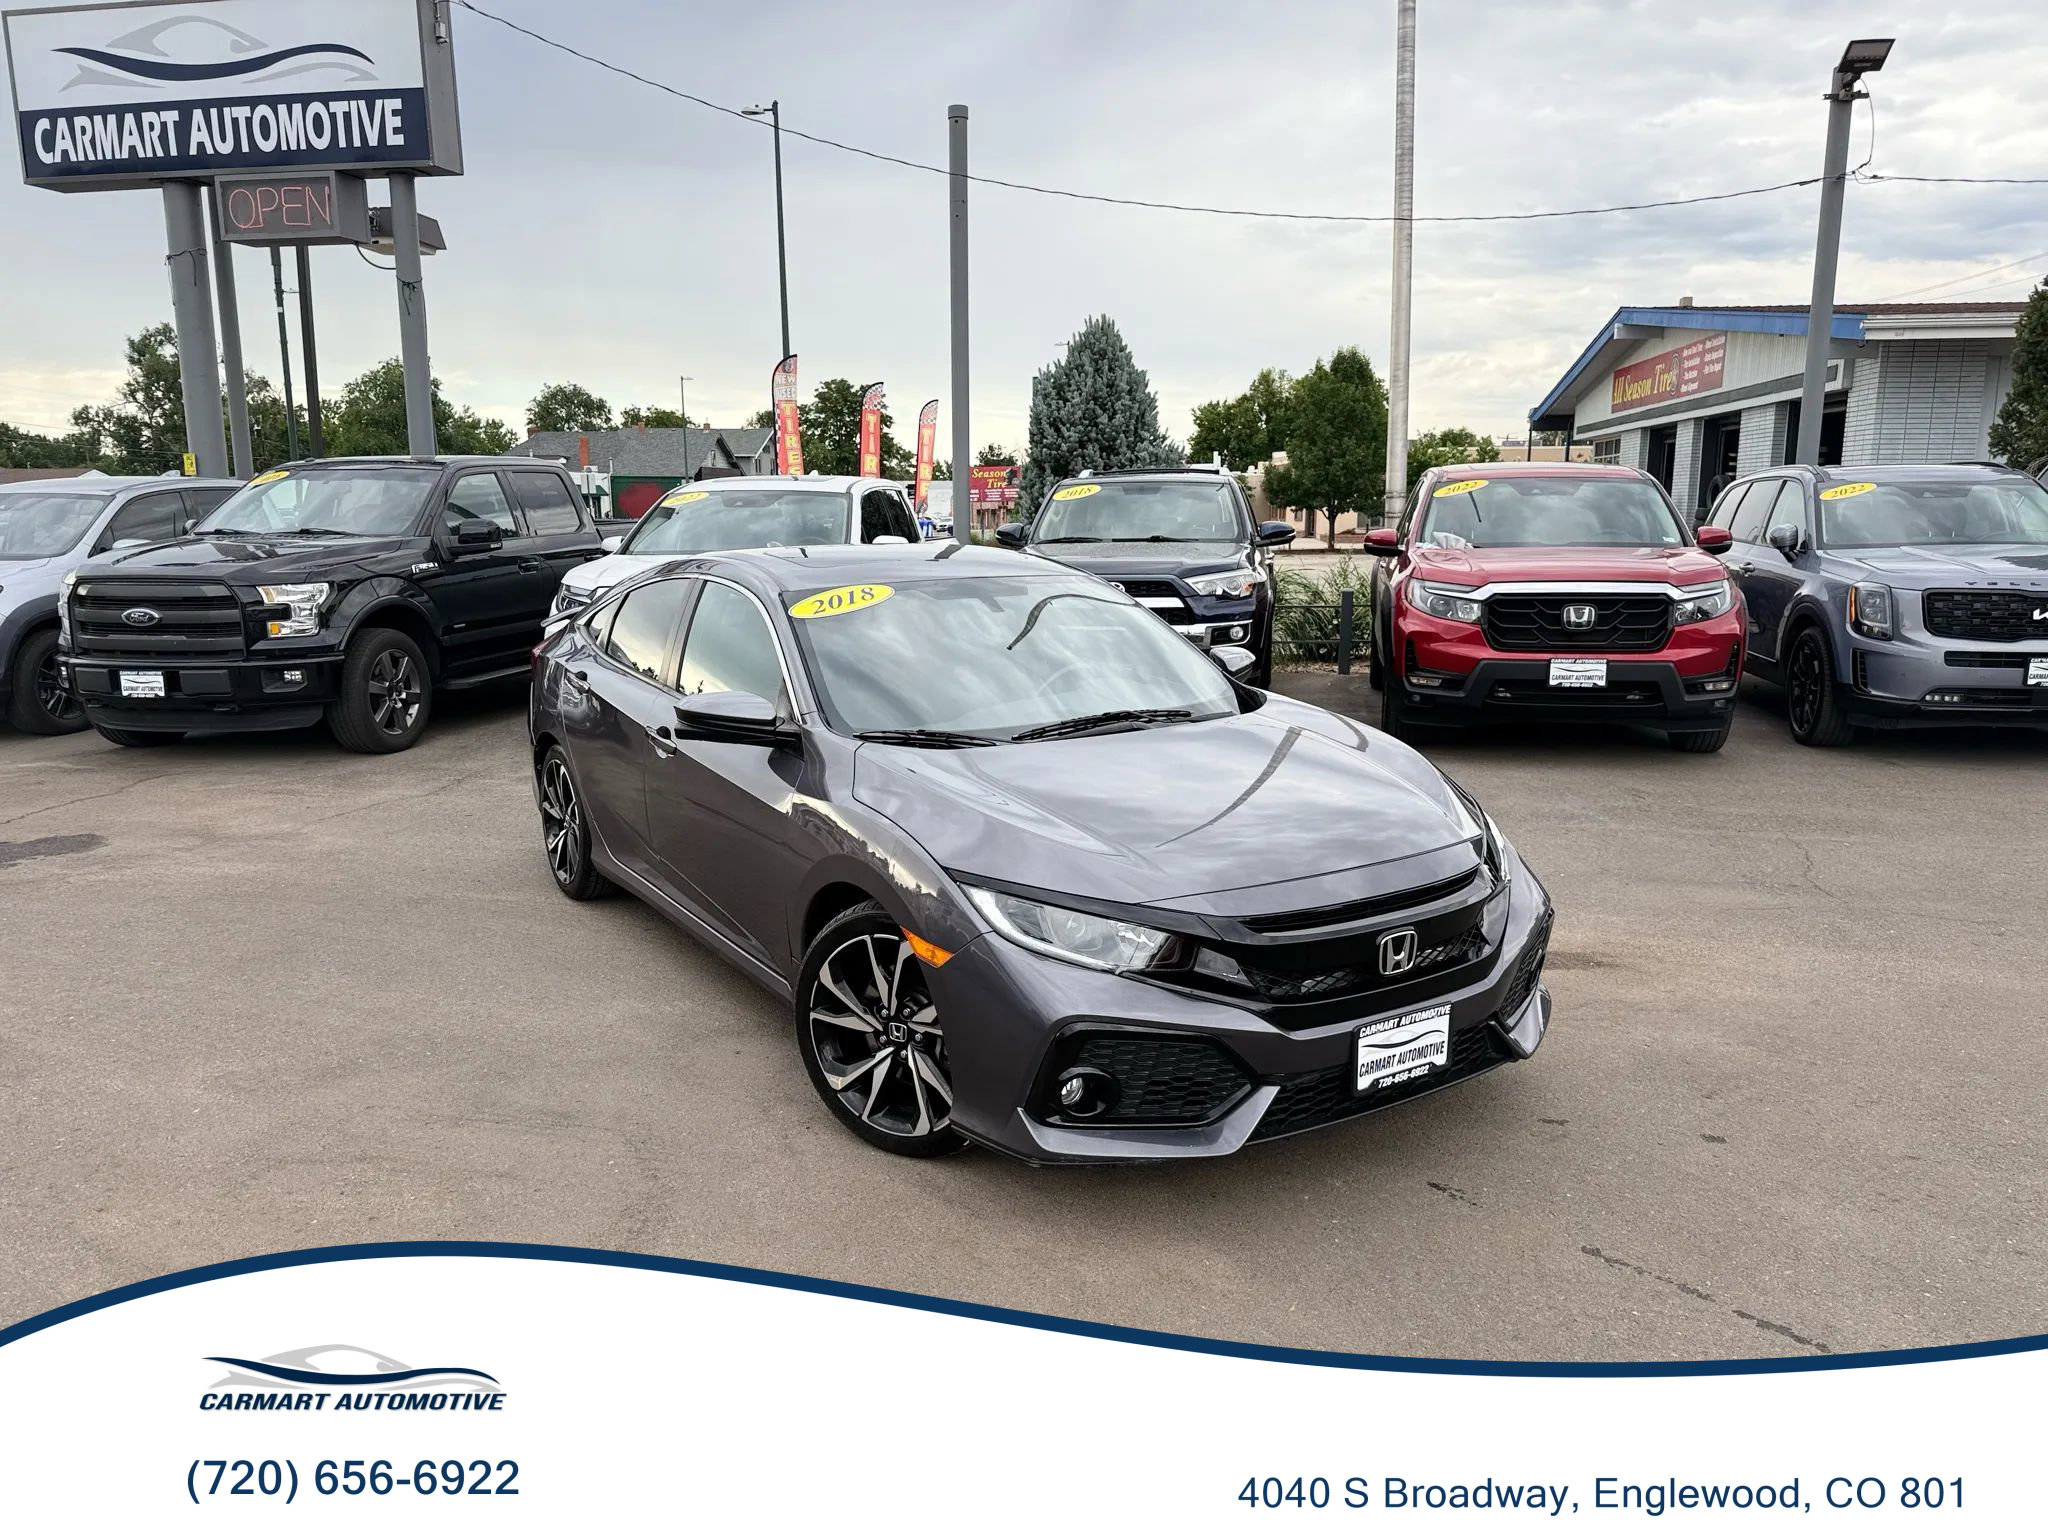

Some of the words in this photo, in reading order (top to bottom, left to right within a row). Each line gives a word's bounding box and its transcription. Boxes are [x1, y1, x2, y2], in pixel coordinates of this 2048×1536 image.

[34, 110, 179, 164] CARMART
[189, 98, 405, 156] AUTOMOTIVE
[228, 185, 331, 229] OPEN
[775, 374, 797, 386] NEW
[1623, 375, 1651, 402] Season
[864, 413, 879, 474] TIR
[972, 468, 1008, 478] Season
[986, 479, 1007, 488] Tire
[1832, 484, 1866, 498] 2022
[811, 586, 875, 615] 2018
[129, 612, 150, 622] Ford
[1575, 674, 1605, 682] AUTOMOTIVE
[1360, 1018, 1400, 1038] CARMART
[1400, 1004, 1452, 1027] AUTOMOTIVE
[1359, 1053, 1397, 1078] CARMART
[1396, 1040, 1446, 1067] AUTOMOTIVE
[1378, 1064, 1430, 1088] 720-656-6922
